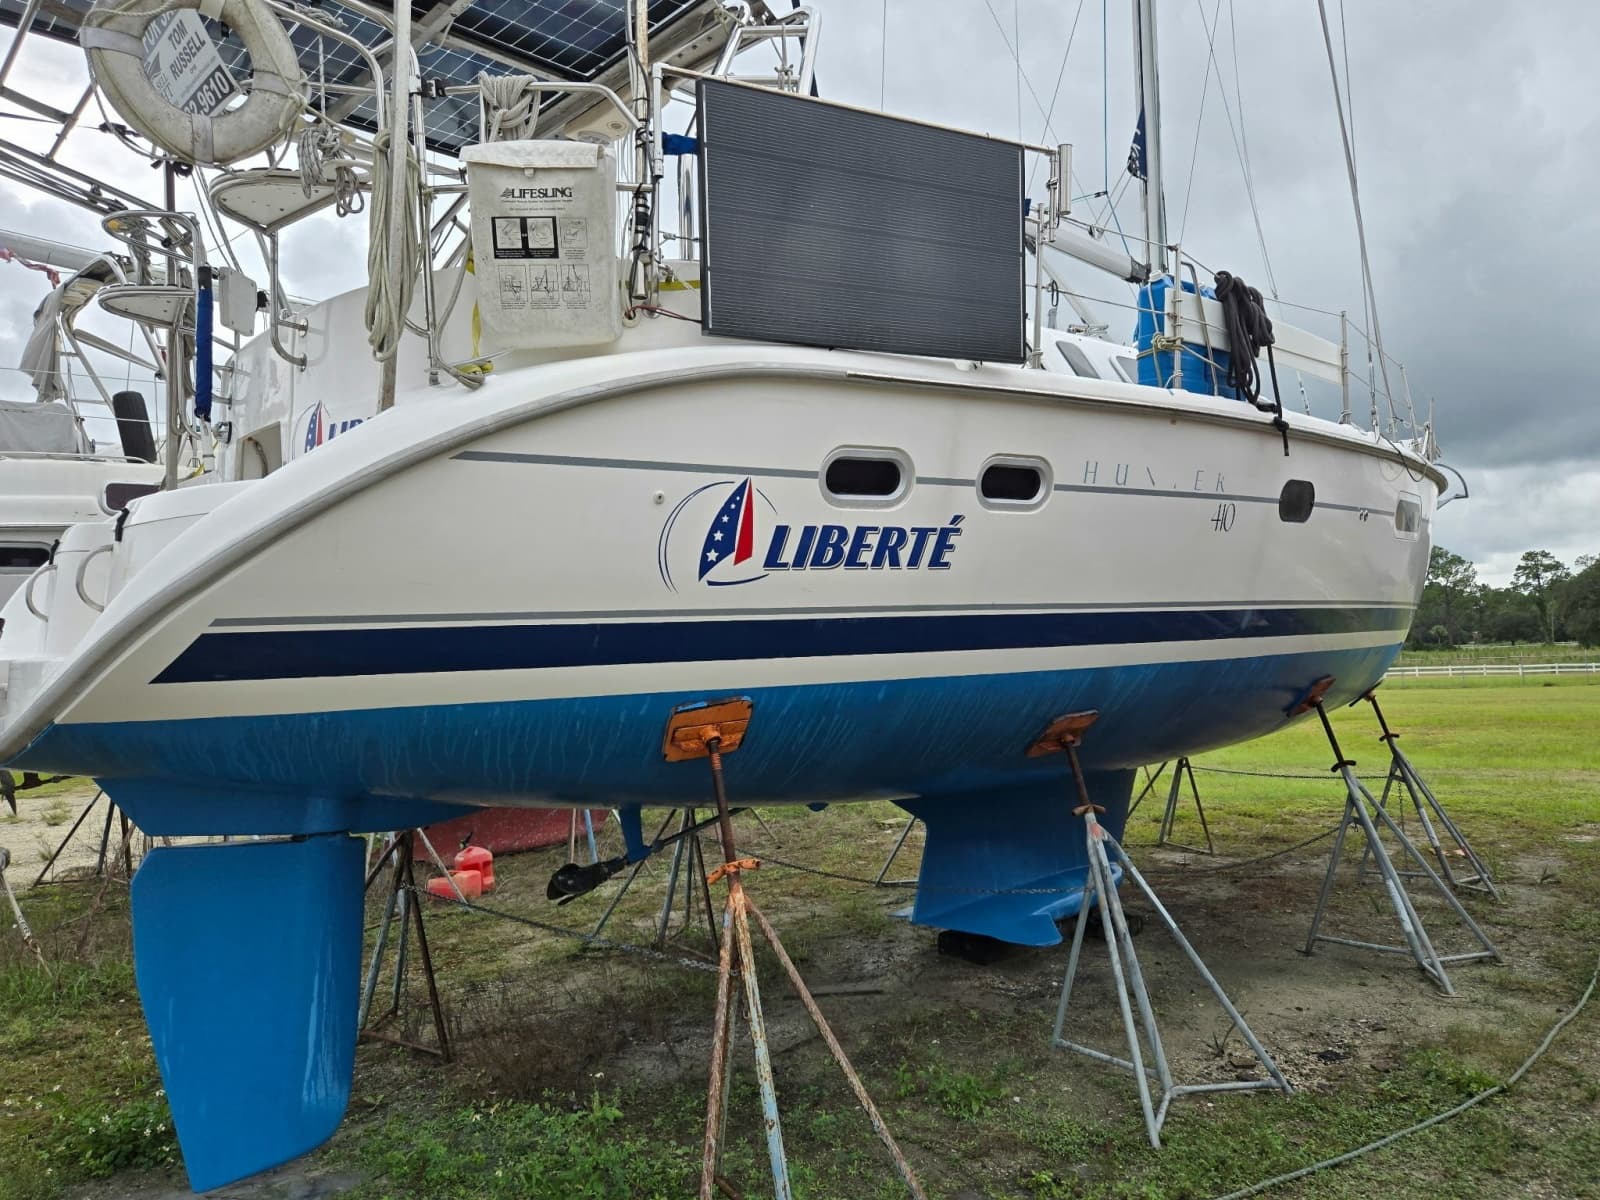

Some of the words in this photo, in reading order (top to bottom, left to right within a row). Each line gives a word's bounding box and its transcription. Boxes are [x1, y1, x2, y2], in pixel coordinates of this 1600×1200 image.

[168, 19, 188, 50] TOM
[169, 31, 206, 80] RUSSELL
[511, 187, 573, 199] LIFESLING
[763, 514, 965, 571] LIBERTÉ
